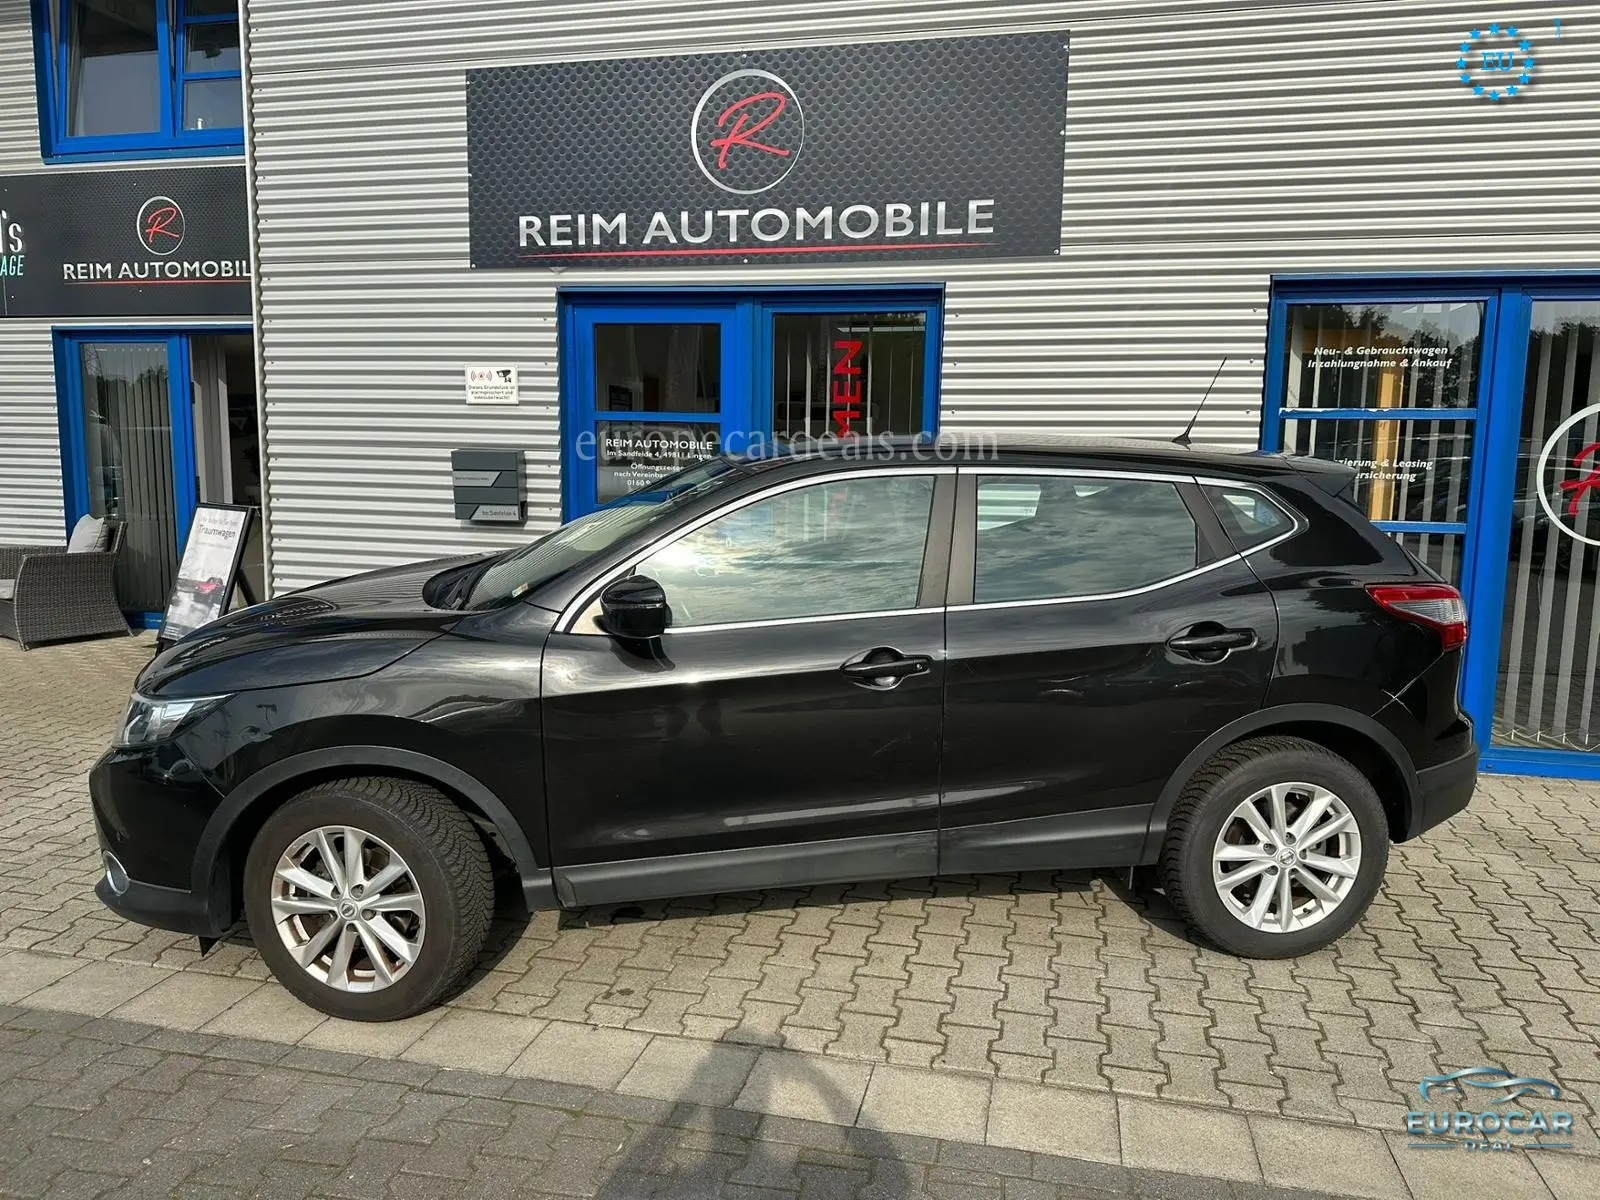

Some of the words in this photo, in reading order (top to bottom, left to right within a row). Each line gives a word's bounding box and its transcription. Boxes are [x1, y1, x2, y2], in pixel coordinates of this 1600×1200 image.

[518, 214, 627, 247] REIM
[642, 199, 996, 245] AUTOMOBILE
[63, 263, 112, 280] REIM
[1314, 347, 1341, 355] Neu-
[1344, 346, 1353, 355] &
[1356, 346, 1448, 357] Gebrauchtwagen
[1308, 358, 1396, 369] Inzahlungnahme
[1399, 358, 1409, 367] &
[1411, 358, 1452, 369] Ankauf
[605, 439, 633, 448] REIM
[635, 440, 713, 450] AUTOMOBILE
[1381, 458, 1390, 467] &
[1393, 459, 1433, 470] Leasing
